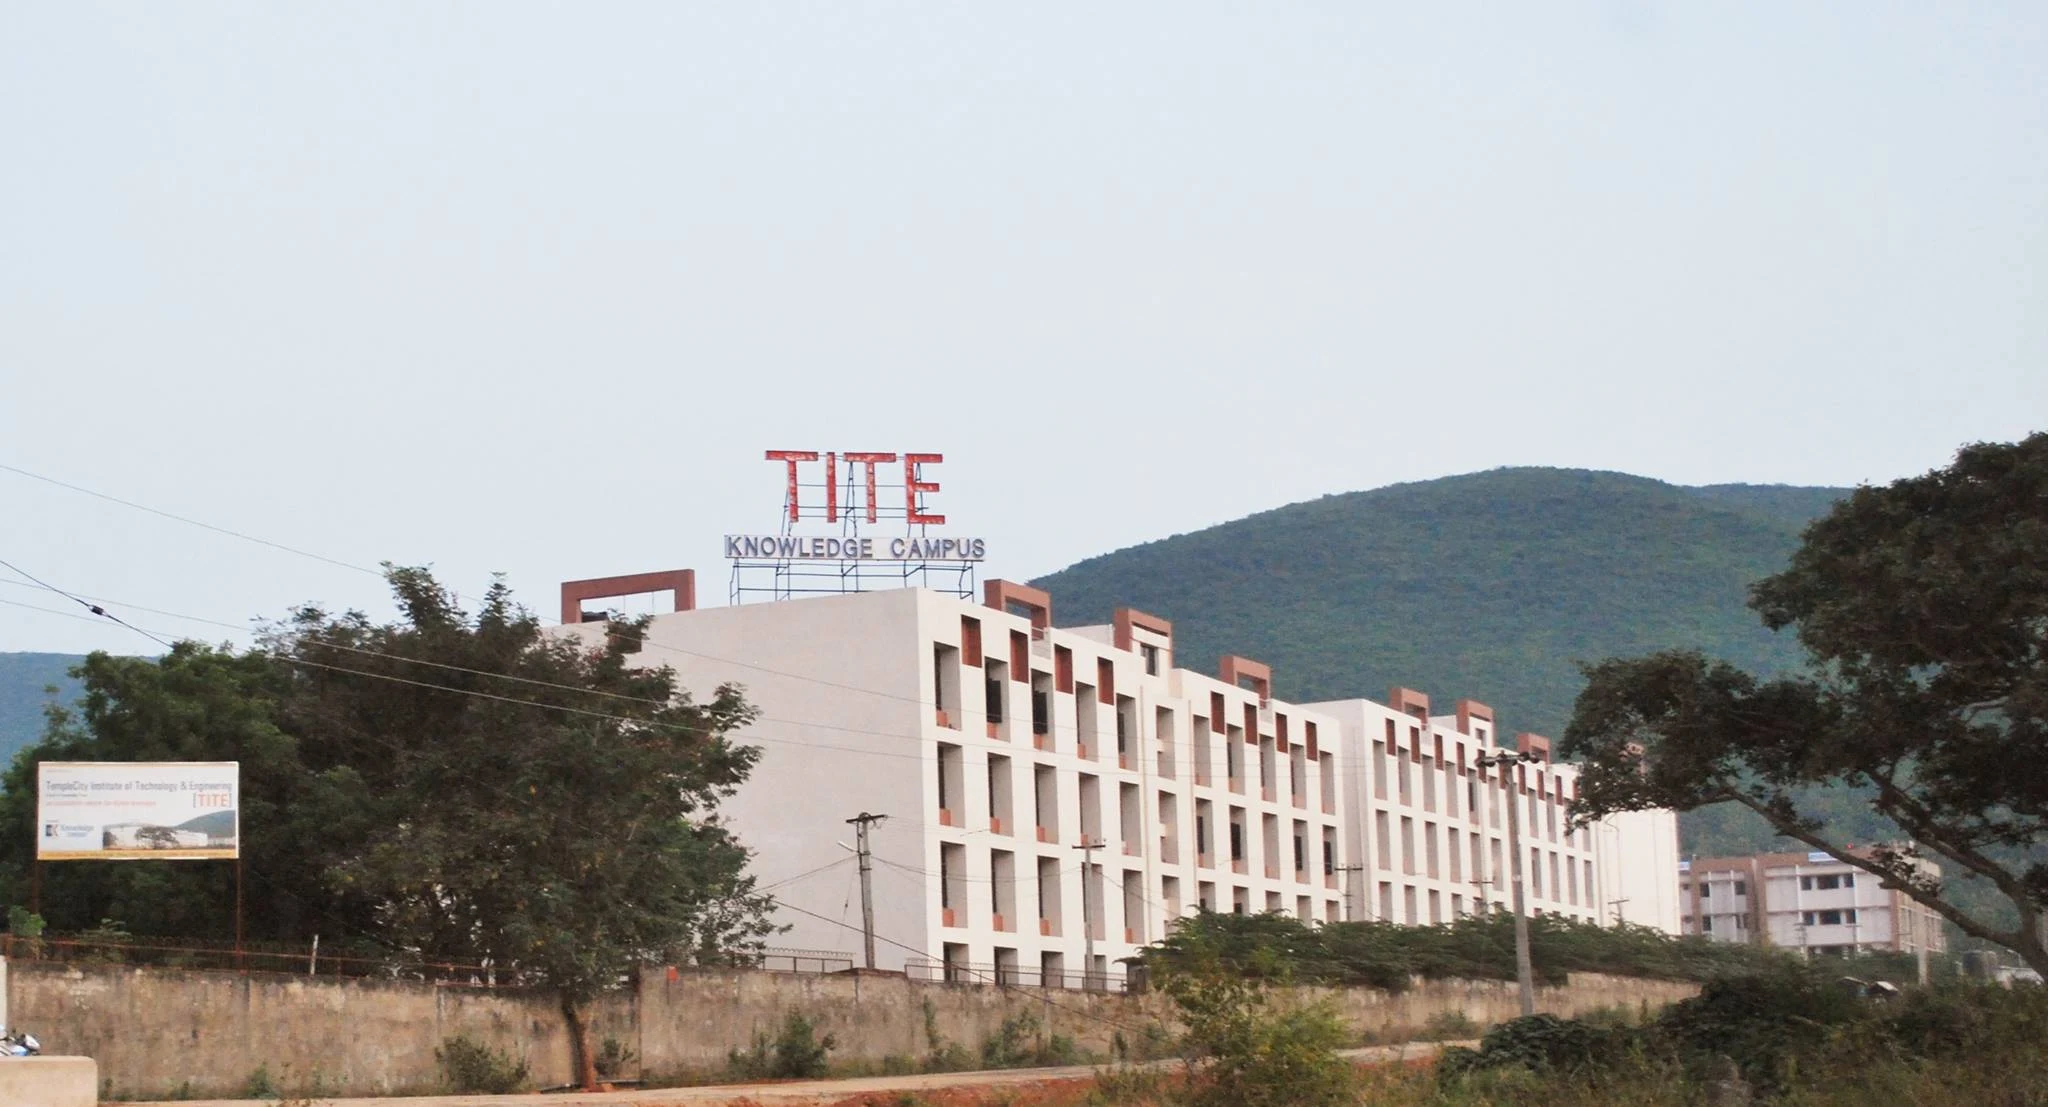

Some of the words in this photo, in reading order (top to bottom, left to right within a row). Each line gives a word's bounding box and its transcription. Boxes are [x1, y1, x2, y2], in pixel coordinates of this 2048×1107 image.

[765, 450, 945, 525] TITE
[727, 536, 873, 558] KNOWLEDGE
[890, 538, 985, 559] CAMPUS
[135, 781, 178, 792] Technology
